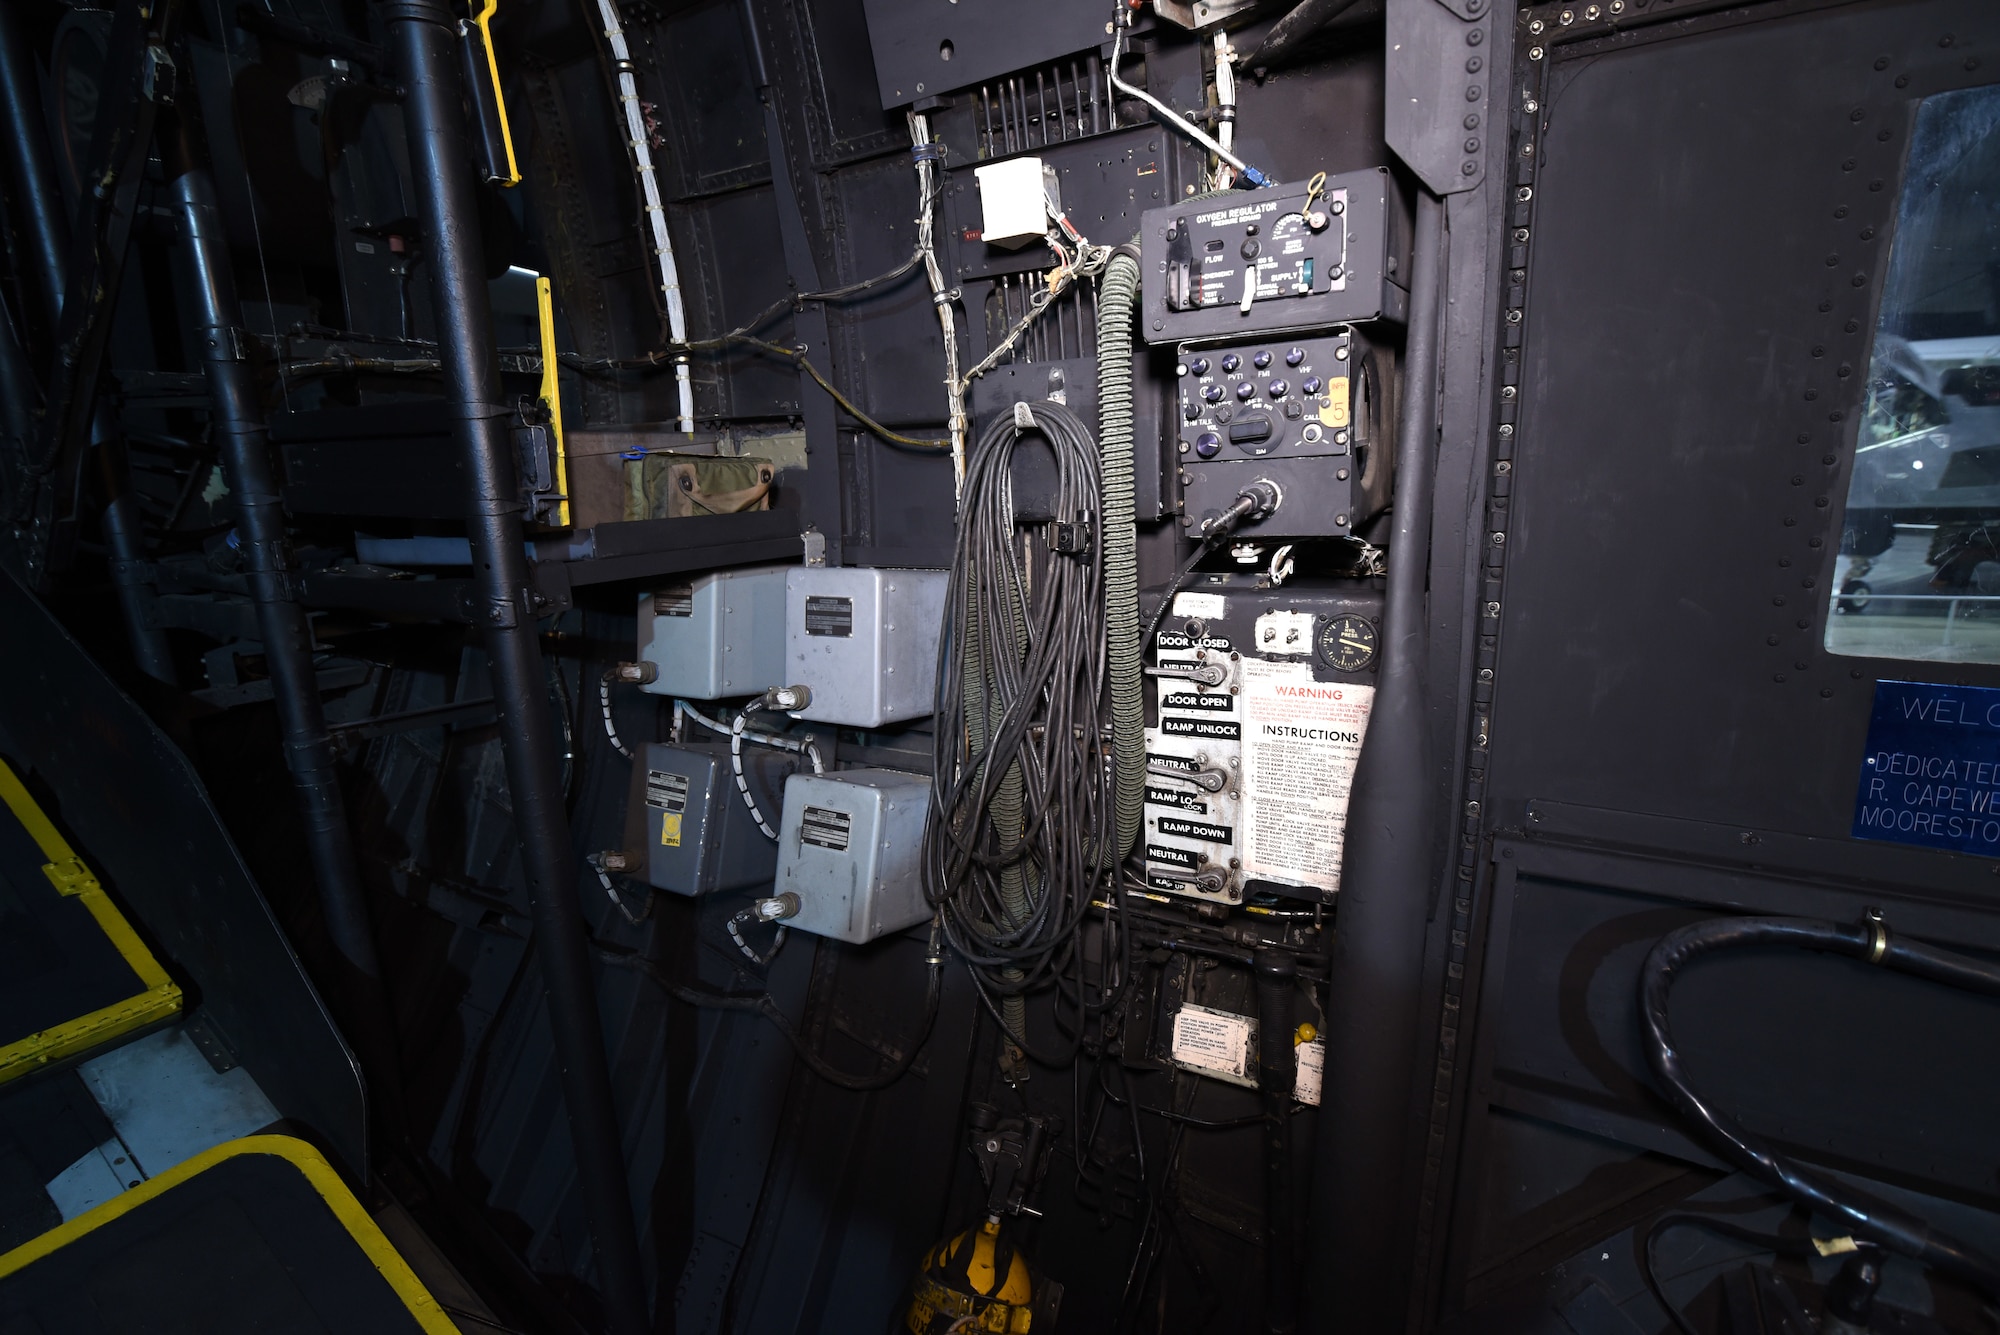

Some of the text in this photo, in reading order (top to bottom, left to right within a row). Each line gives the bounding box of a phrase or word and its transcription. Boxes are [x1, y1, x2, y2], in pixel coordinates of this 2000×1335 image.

[1196, 202, 1277, 224] OXYGEN REGULATOR
[1205, 255, 1223, 264] FLOW
[1271, 272, 1298, 282] SUPPLY
[1200, 376, 1214, 384] INPH
[1228, 373, 1243, 381] PVT1
[1332, 382, 1346, 390] INPH
[1334, 402, 1345, 420] 5
[1160, 636, 1189, 647] DOOR
[1275, 686, 1343, 700] WARNING
[1168, 695, 1227, 707] DOOR OPEN
[1166, 722, 1237, 735] RAMP UNLOCK
[1263, 725, 1359, 743] INSTRUCTIONS
[1150, 757, 1191, 770] NEUTRAL
[1869, 778, 1889, 801] R.
[1151, 791, 1177, 802] RAMP
[1164, 822, 1225, 838] RAMP DOWN
[1150, 849, 1189, 862] NEUTRAL
